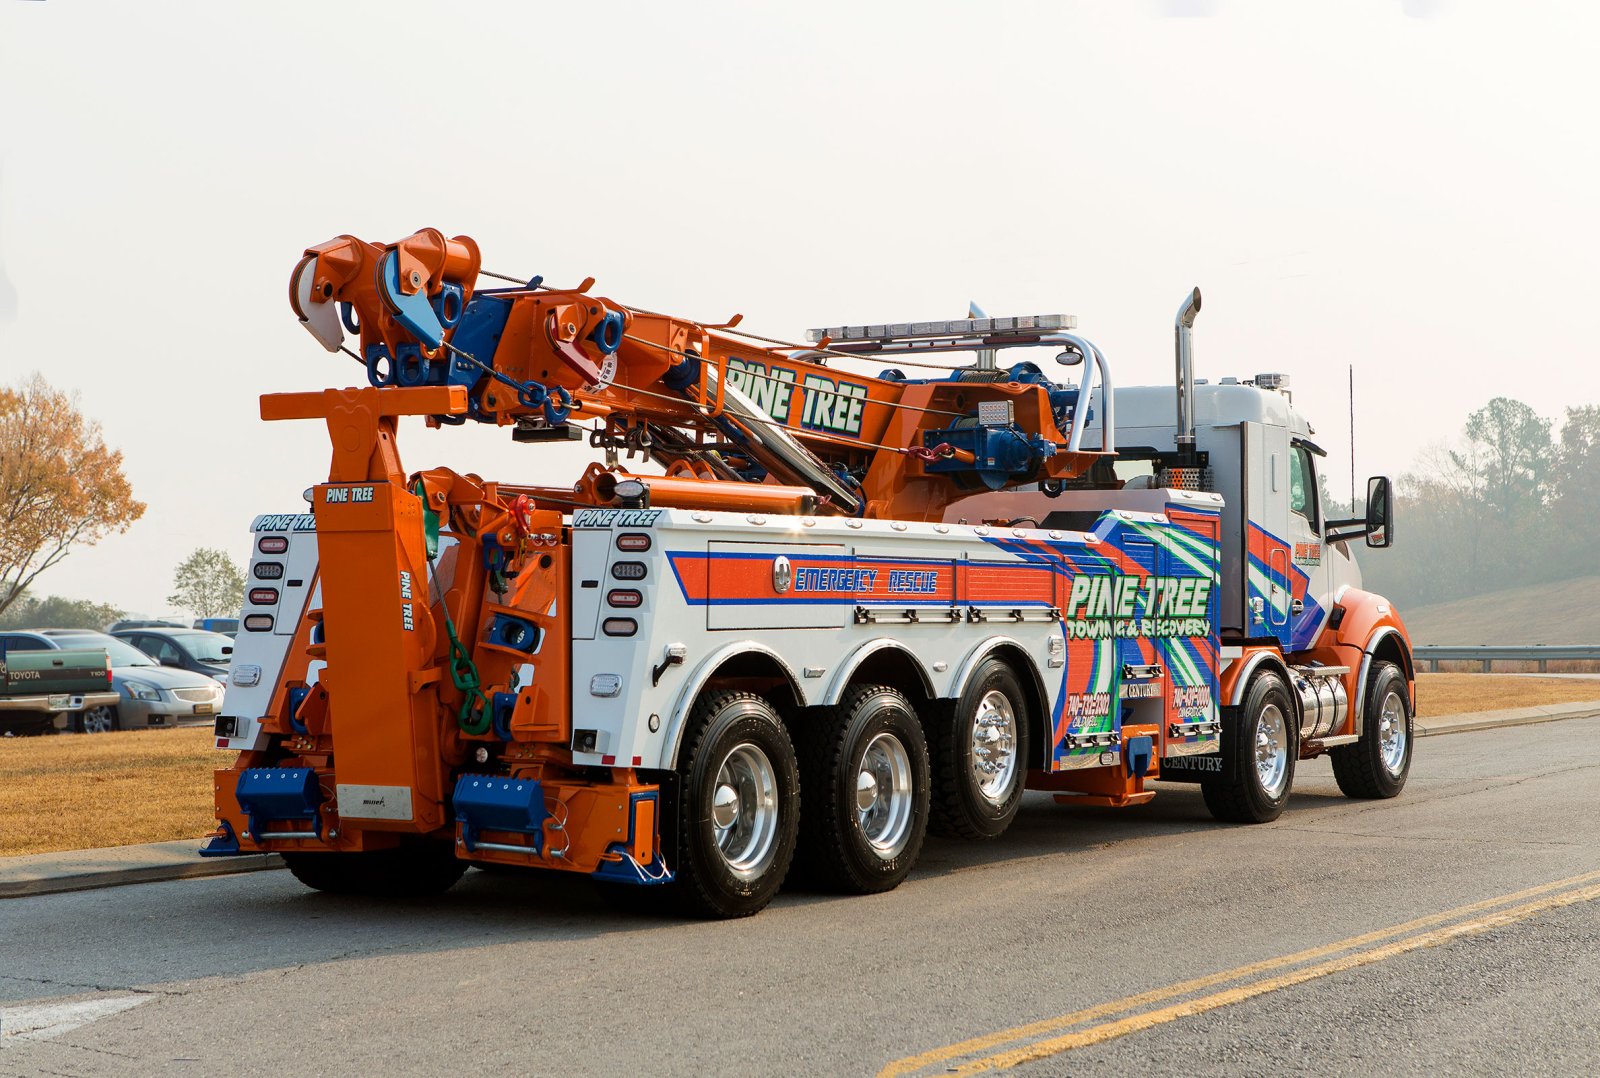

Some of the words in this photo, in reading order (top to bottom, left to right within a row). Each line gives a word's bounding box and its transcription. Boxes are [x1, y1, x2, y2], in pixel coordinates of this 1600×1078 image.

[727, 357, 796, 424] PINE
[801, 374, 867, 438] TREE
[326, 487, 349, 503] PINE
[351, 487, 374, 502] TREE
[256, 515, 295, 531] PINE
[574, 510, 619, 527] PINE
[617, 510, 662, 527] TREE
[400, 570, 412, 600] PINE
[888, 570, 938, 593] RESCUE
[1066, 574, 1141, 619] PINE
[1143, 576, 1212, 619] TREE
[402, 603, 414, 631] TREE
[1067, 619, 1125, 640] TOWING
[1126, 620, 1140, 637] &
[1141, 619, 1211, 638] RECOVERY
[9, 671, 41, 680] TOYOTA
[1163, 756, 1222, 772] CENTURY
